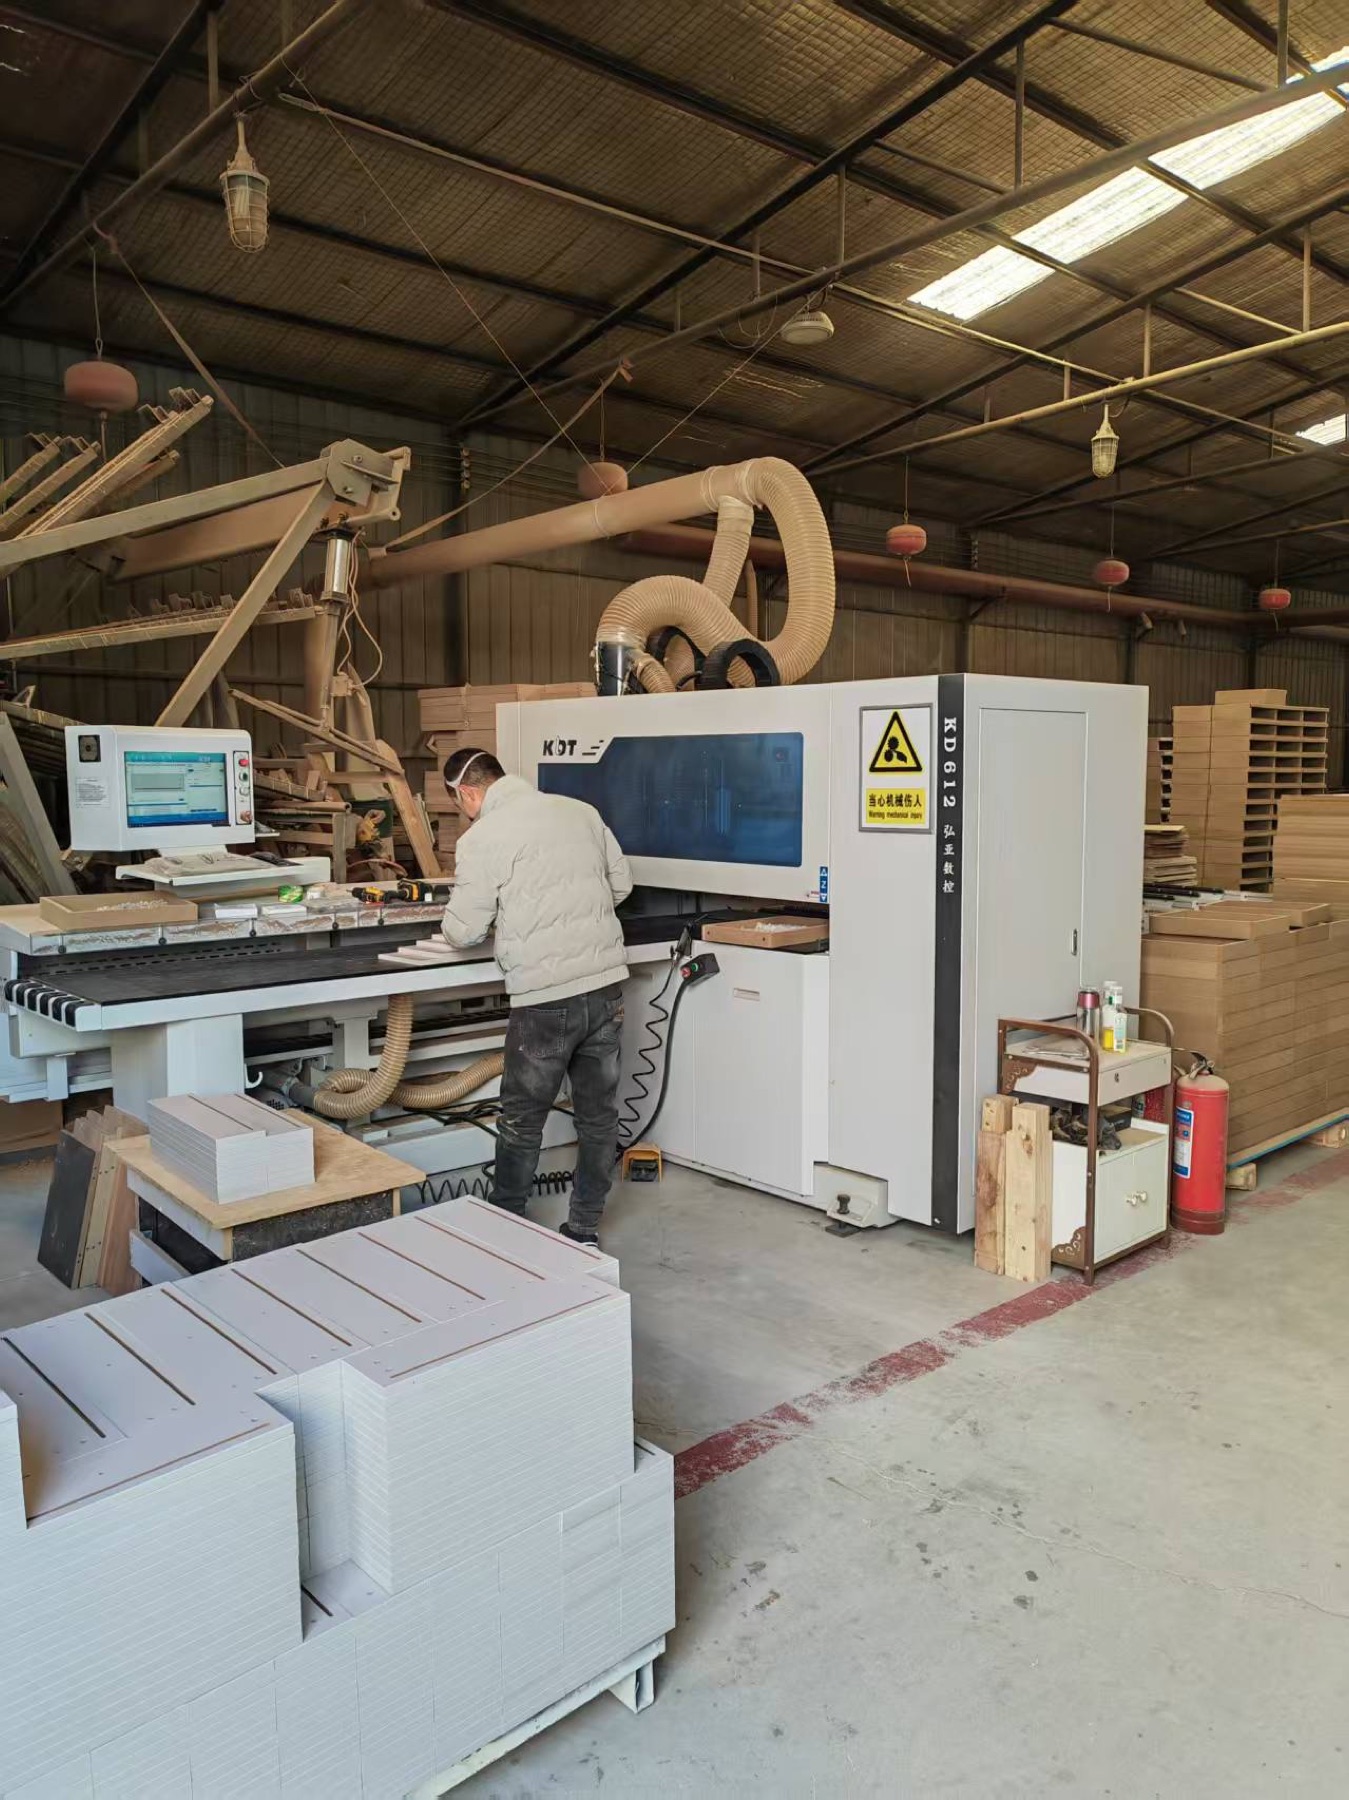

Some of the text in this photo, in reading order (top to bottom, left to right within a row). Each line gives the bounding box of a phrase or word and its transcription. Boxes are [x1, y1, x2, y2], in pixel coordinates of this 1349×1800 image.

[543, 738, 577, 756] KDT
[868, 793, 922, 807] 当心机械伤人
[943, 824, 955, 893] 弘亚数控
